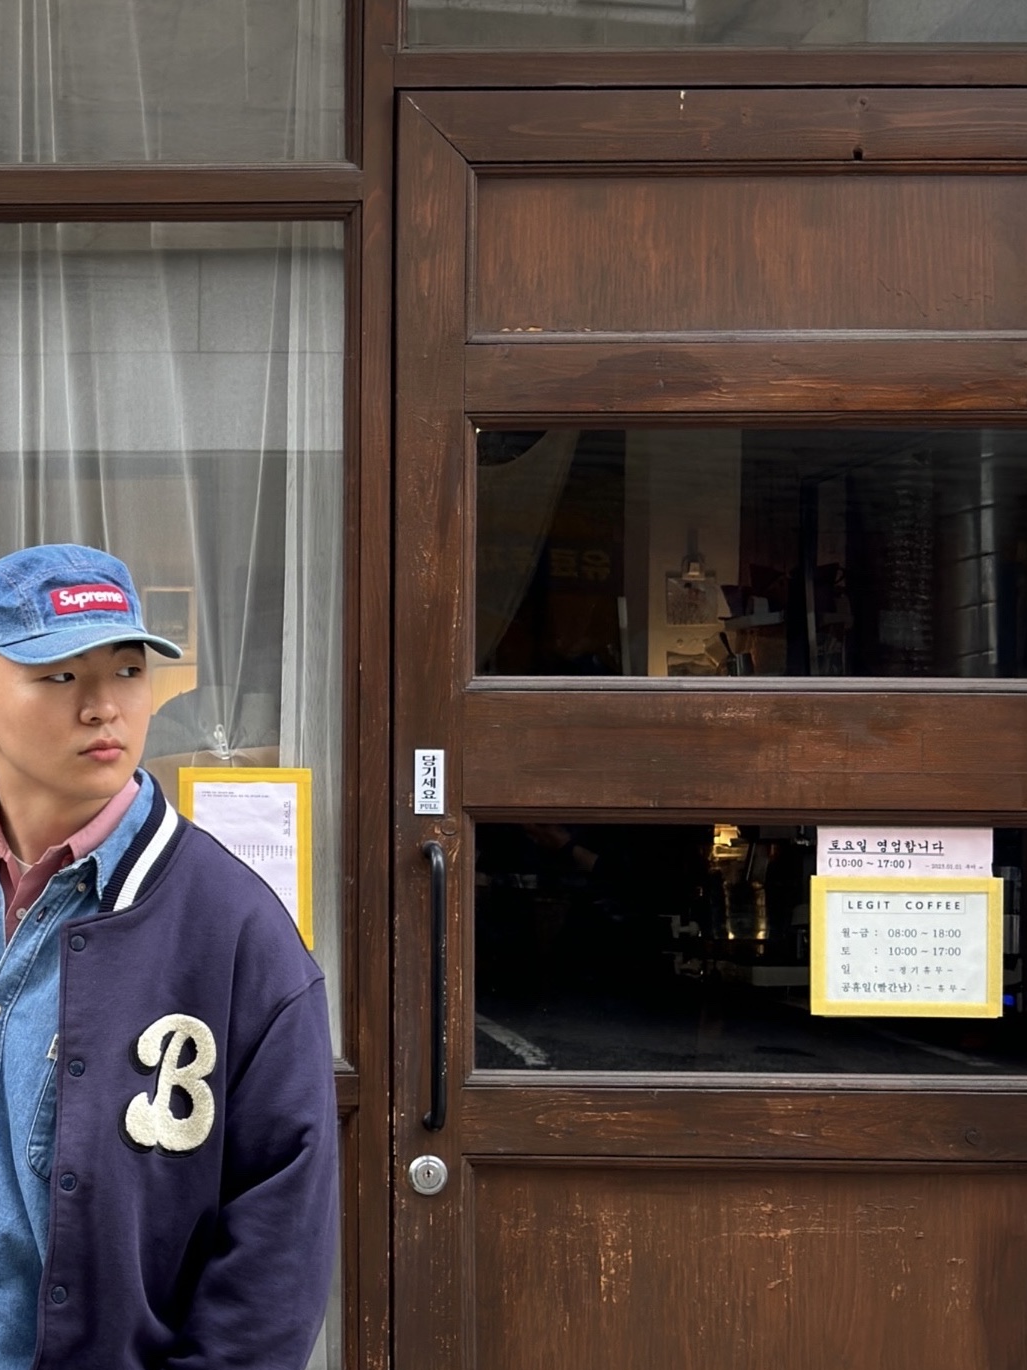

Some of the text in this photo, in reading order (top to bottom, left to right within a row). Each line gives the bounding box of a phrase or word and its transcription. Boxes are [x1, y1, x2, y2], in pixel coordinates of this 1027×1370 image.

[58, 590, 124, 608] Supreme
[421, 755, 437, 800] 당기세요
[828, 839, 944, 854] 토요일 영업합니다
[847, 900, 961, 910] LEGIT COFFEE
[887, 928, 918, 938] 08:00
[932, 928, 962, 939] 18:00
[840, 946, 851, 956] 토
[888, 946, 918, 957] 10:00
[932, 946, 962, 957] 17:00
[841, 963, 851, 975] 일
[121, 1012, 218, 1156] B
